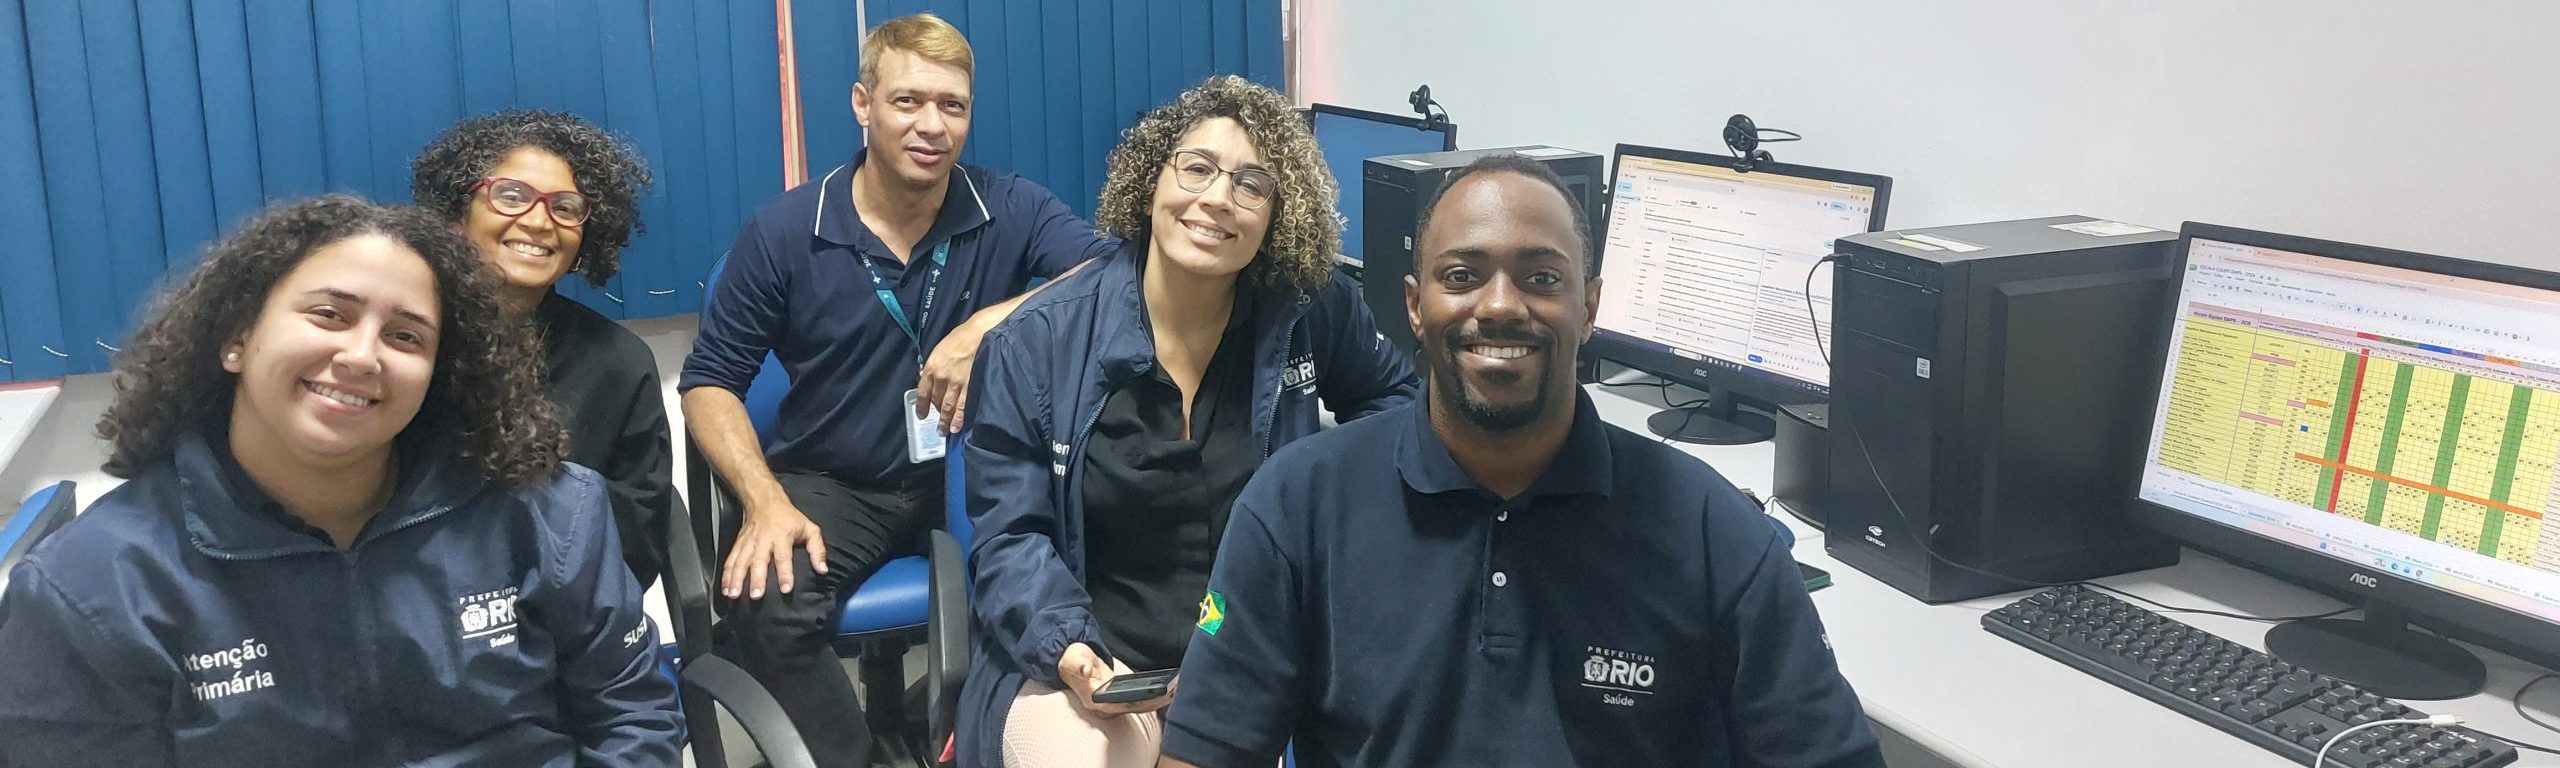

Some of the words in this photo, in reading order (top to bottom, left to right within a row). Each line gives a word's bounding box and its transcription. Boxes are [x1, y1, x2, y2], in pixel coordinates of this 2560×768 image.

[925, 287, 936, 309] SAÚDE
[1298, 360, 1316, 381] RI
[2349, 572, 2378, 588] AOC
[1587, 645, 1655, 663] PREFEITURA
[1609, 659, 1655, 687] RIO
[1603, 693, 1635, 706] Saúde
